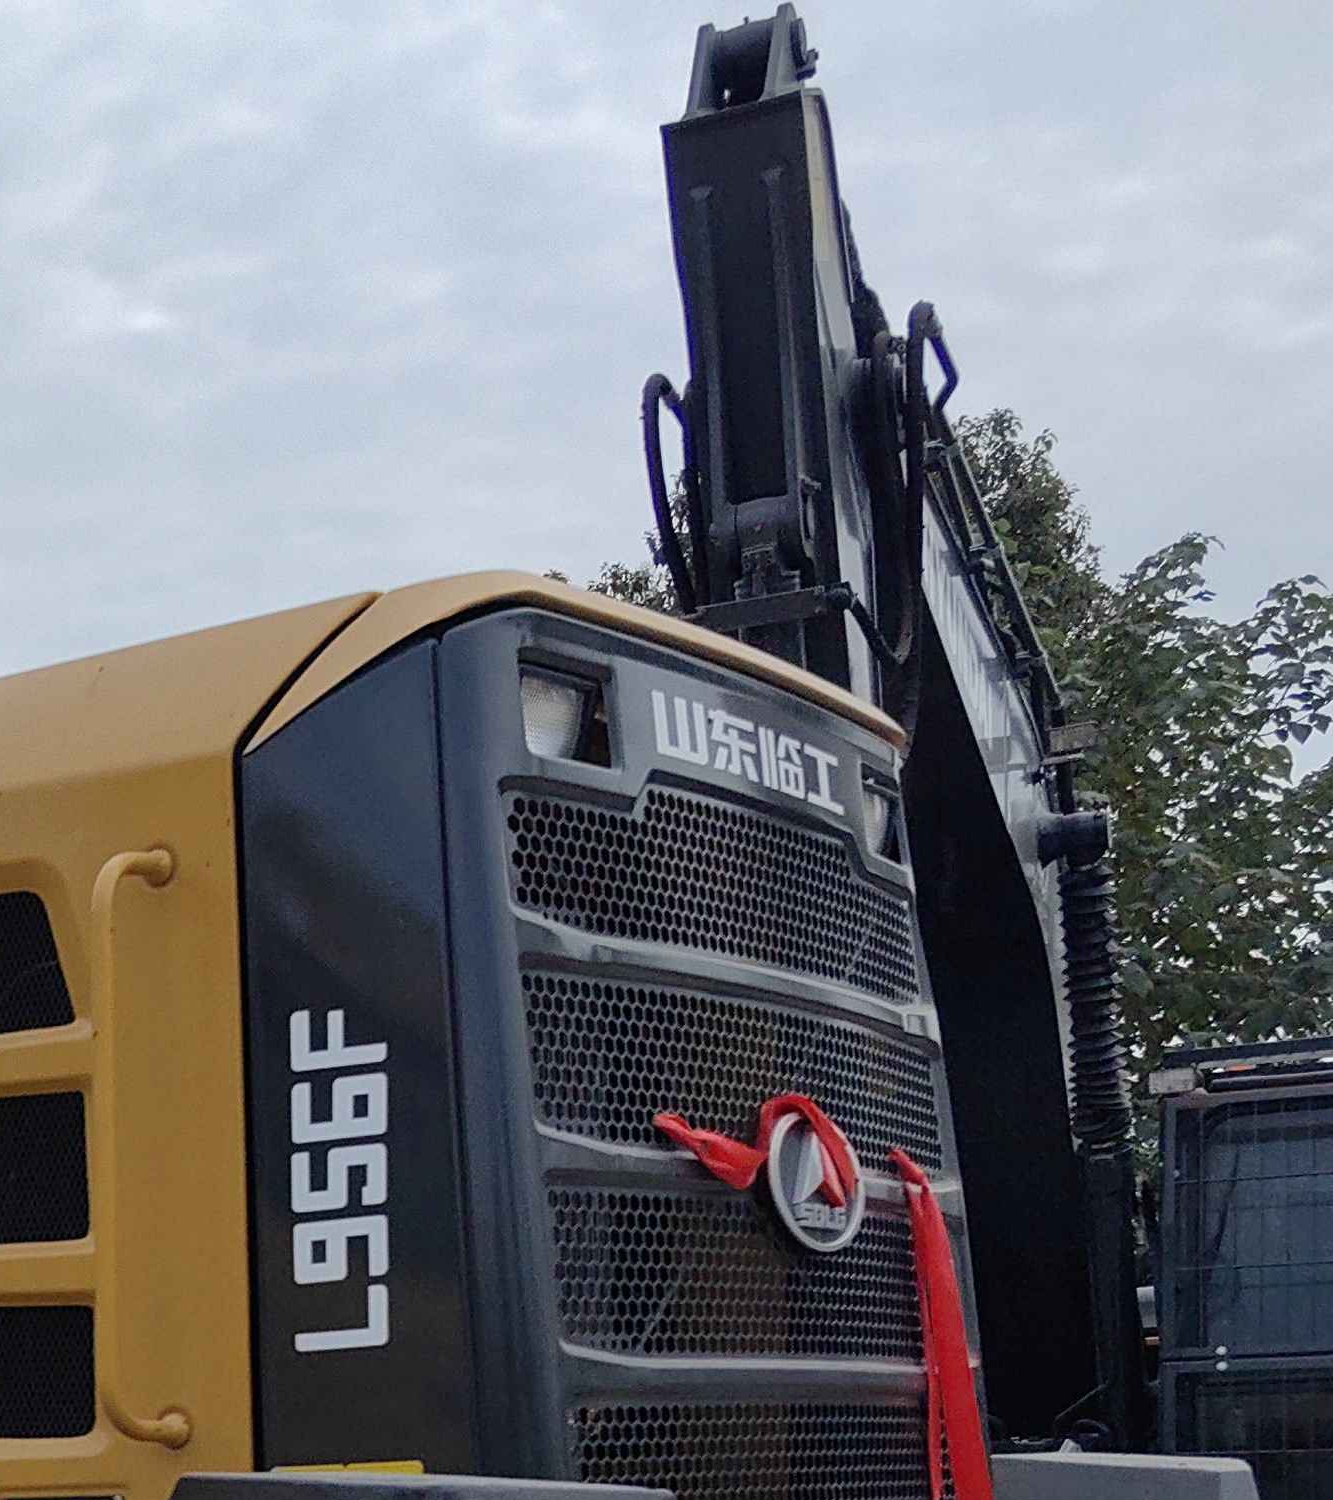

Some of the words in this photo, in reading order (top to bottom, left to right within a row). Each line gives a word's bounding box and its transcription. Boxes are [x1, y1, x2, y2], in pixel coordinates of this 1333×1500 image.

[651, 689, 845, 817] 山东临工
[290, 1009, 390, 1352] L956F
[792, 1203, 848, 1231] SDLG
